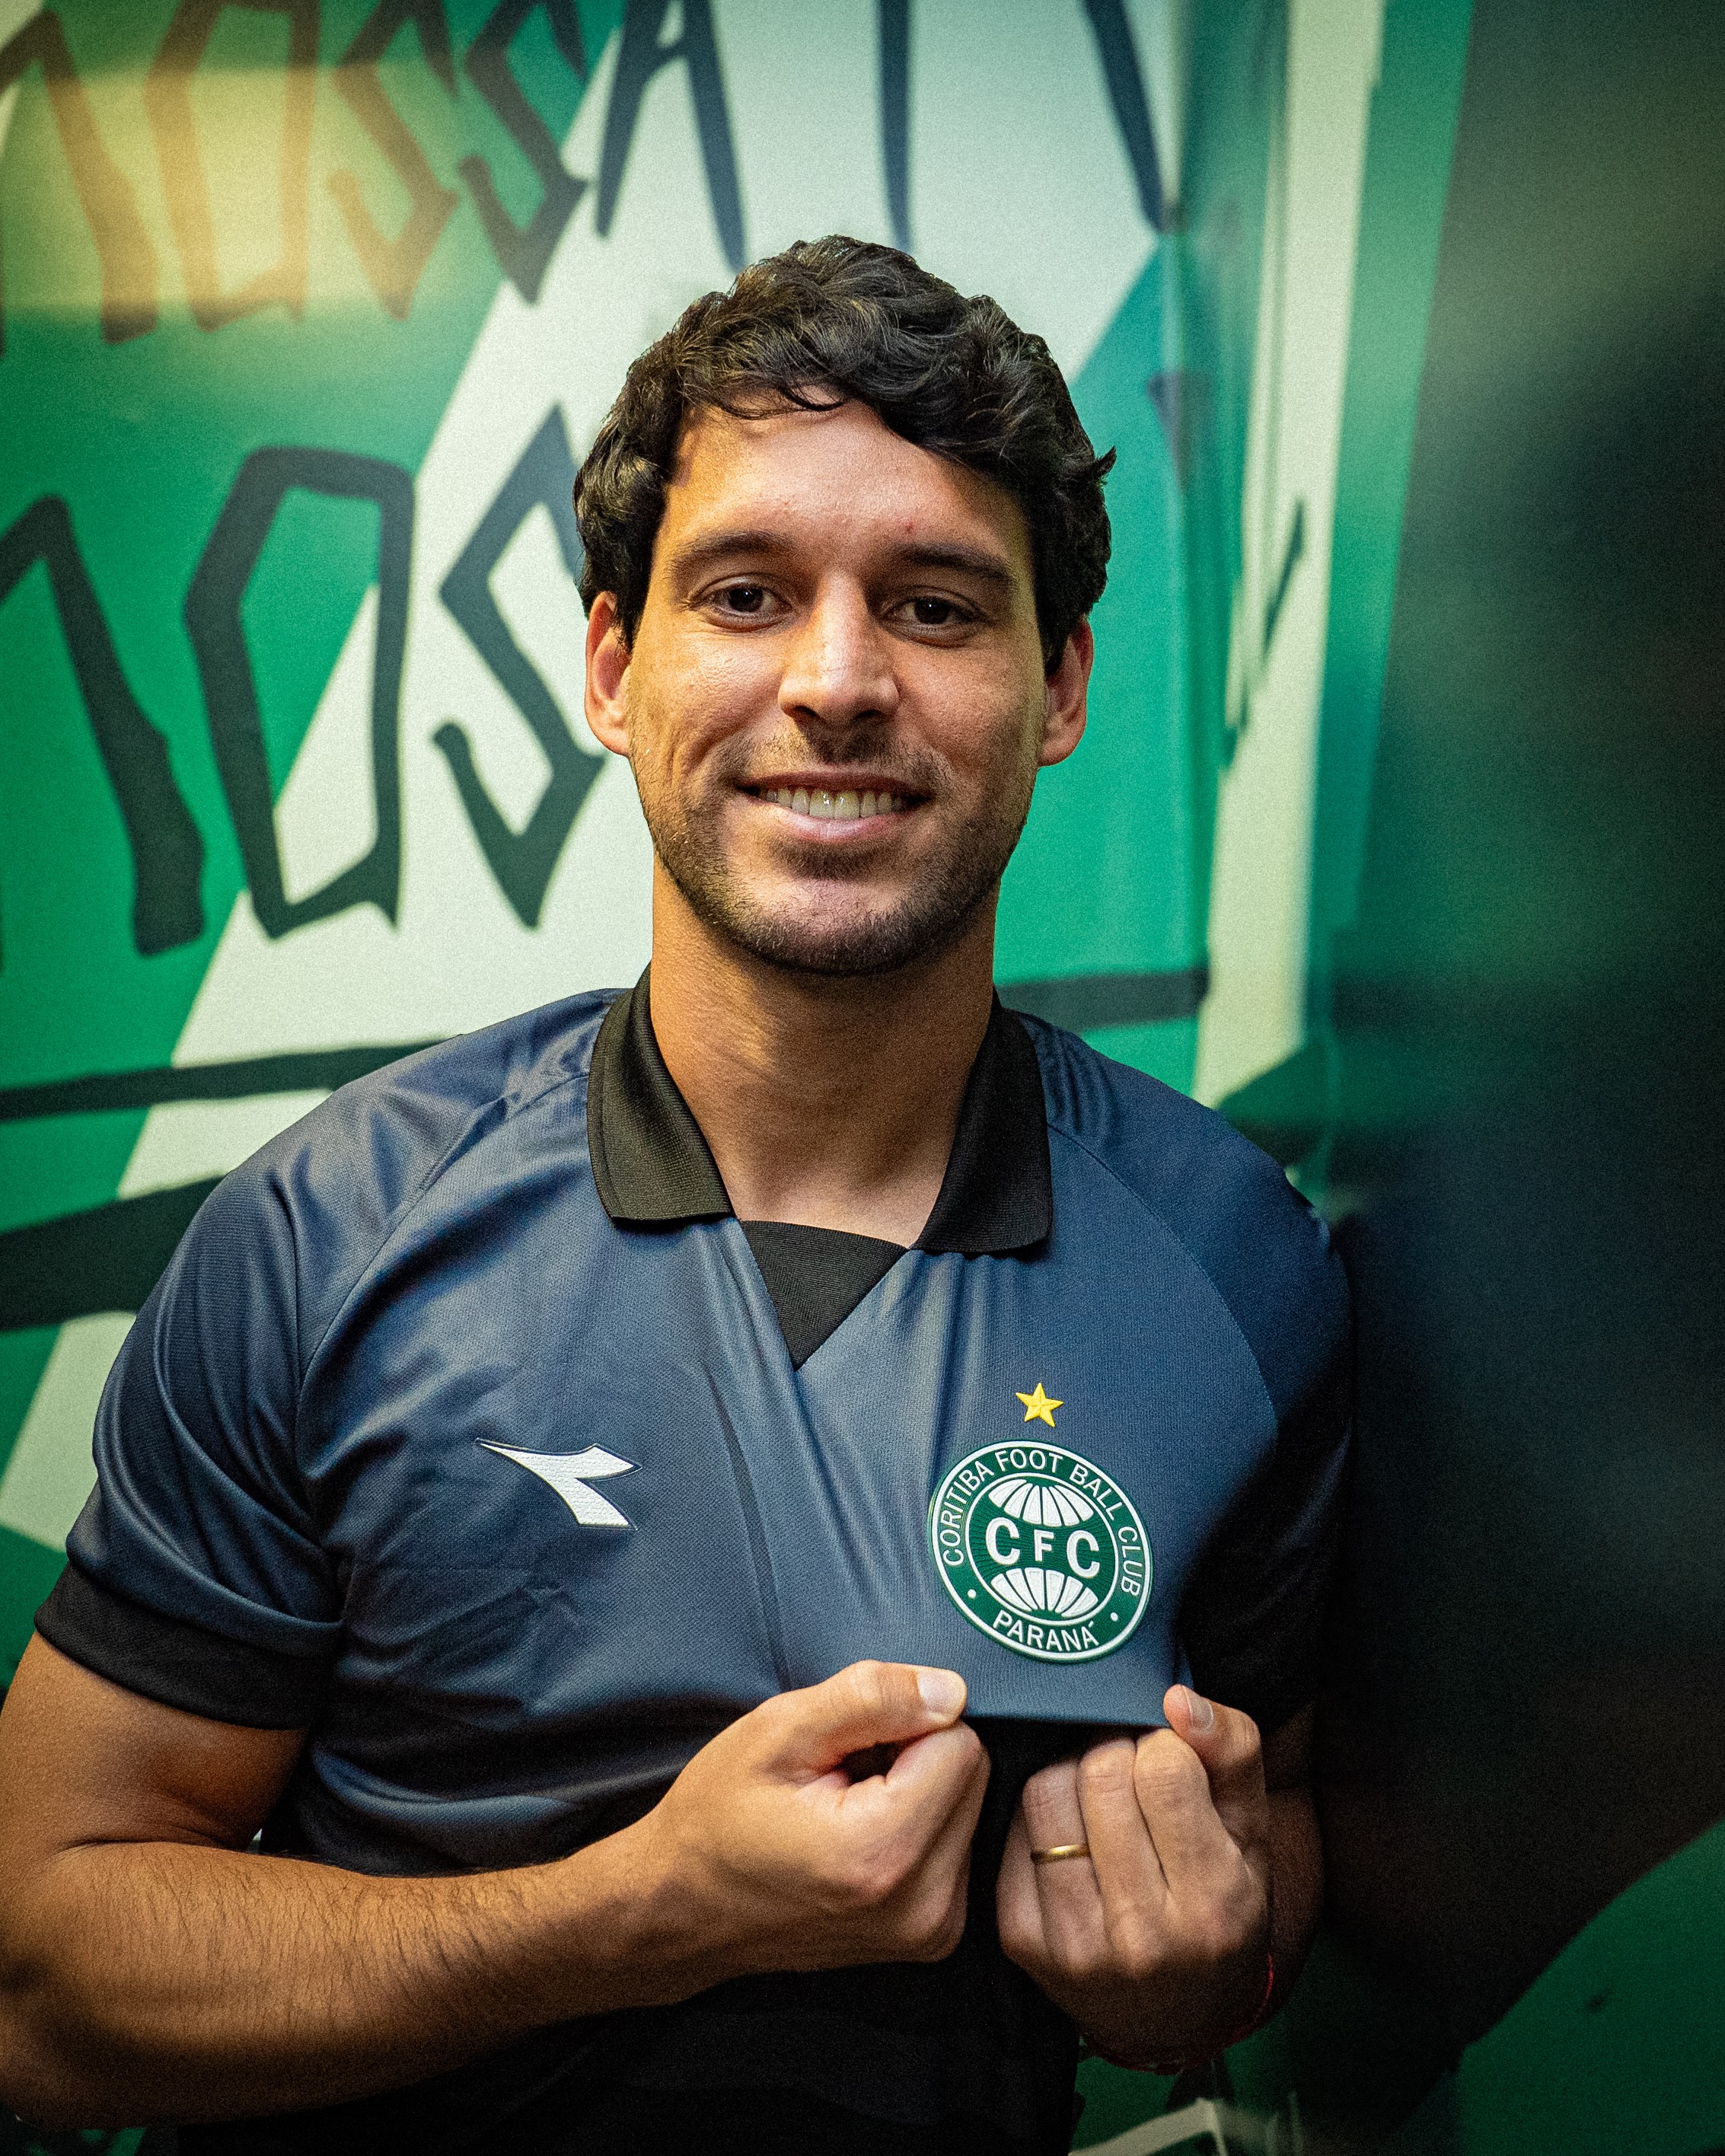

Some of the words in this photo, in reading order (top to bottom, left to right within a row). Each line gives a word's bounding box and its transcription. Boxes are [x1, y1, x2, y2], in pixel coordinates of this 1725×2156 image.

[939, 1460, 995, 1567] CORITIBA
[994, 1448, 1063, 1473] FOOT
[1069, 1462, 1123, 1521] BALL
[1118, 1526, 1143, 1596] CLUB
[985, 1517, 1101, 1579] CFC
[992, 1609, 1099, 1652] PARANÁ
